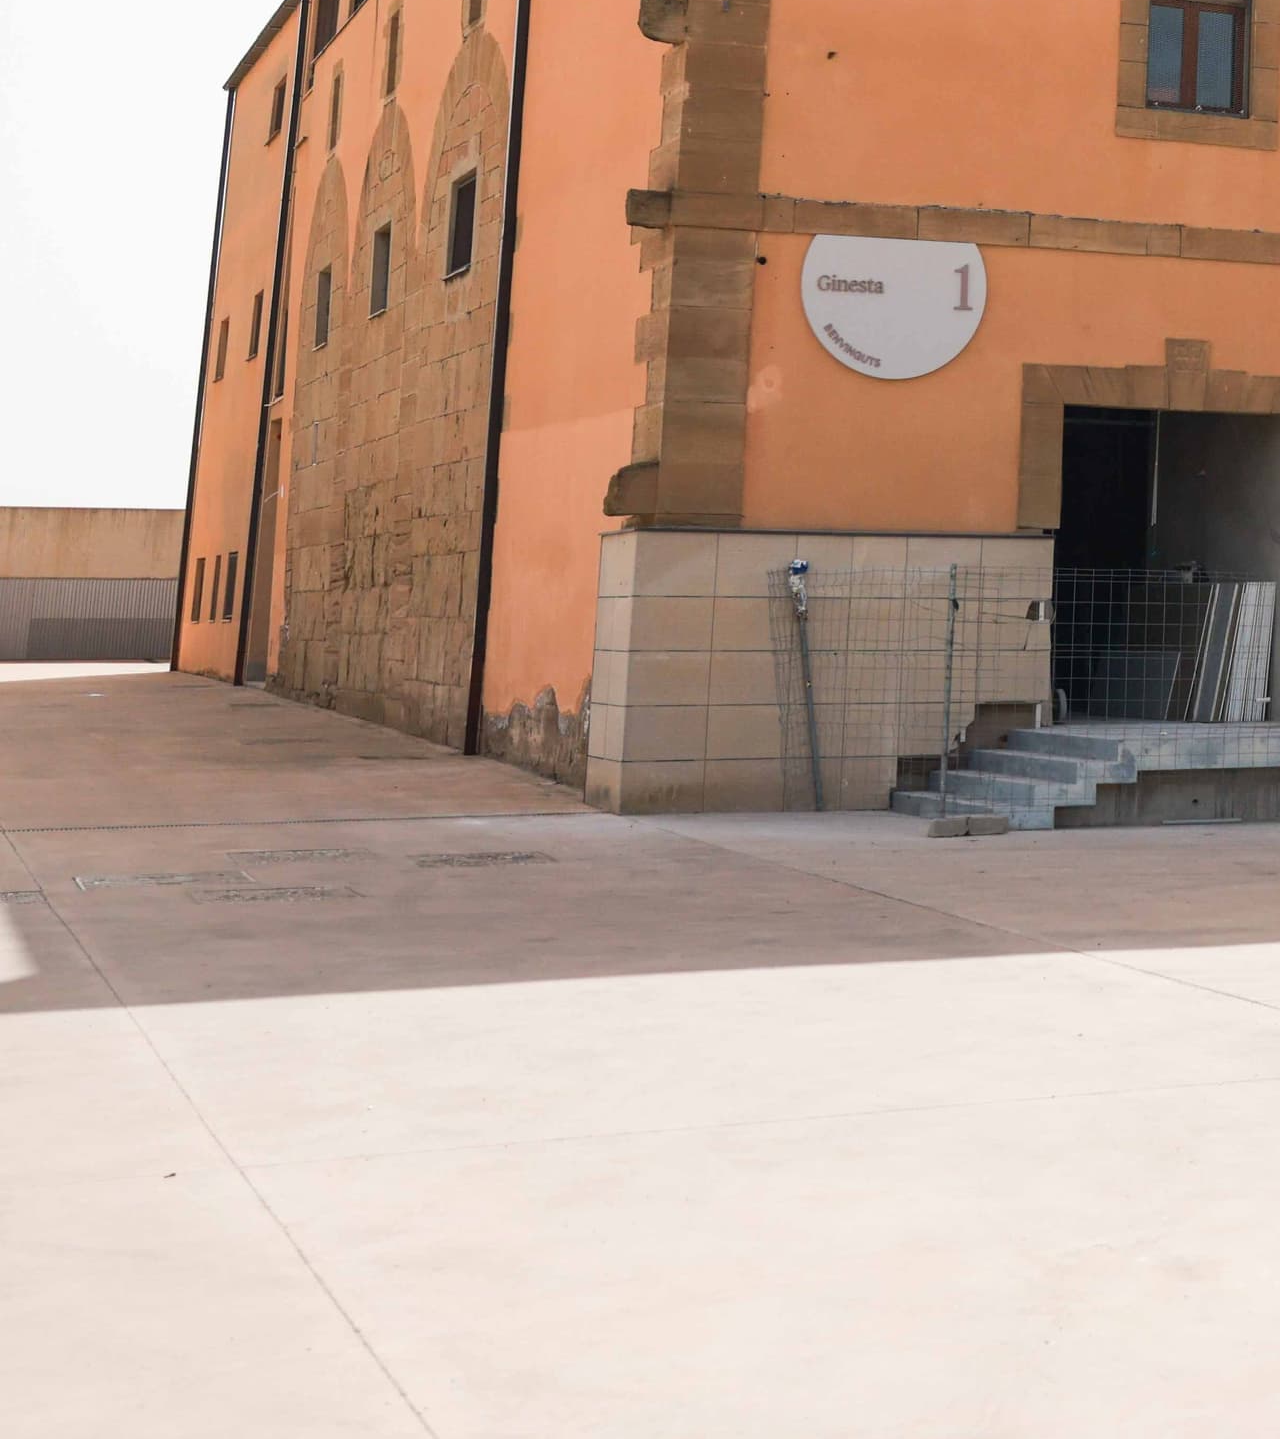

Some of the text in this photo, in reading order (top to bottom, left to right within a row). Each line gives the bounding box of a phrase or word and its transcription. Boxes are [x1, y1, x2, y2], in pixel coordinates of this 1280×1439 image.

[817, 274, 884, 294] Ginesta
[953, 263, 973, 311] 1
[823, 323, 881, 368] BENVINGUTS
